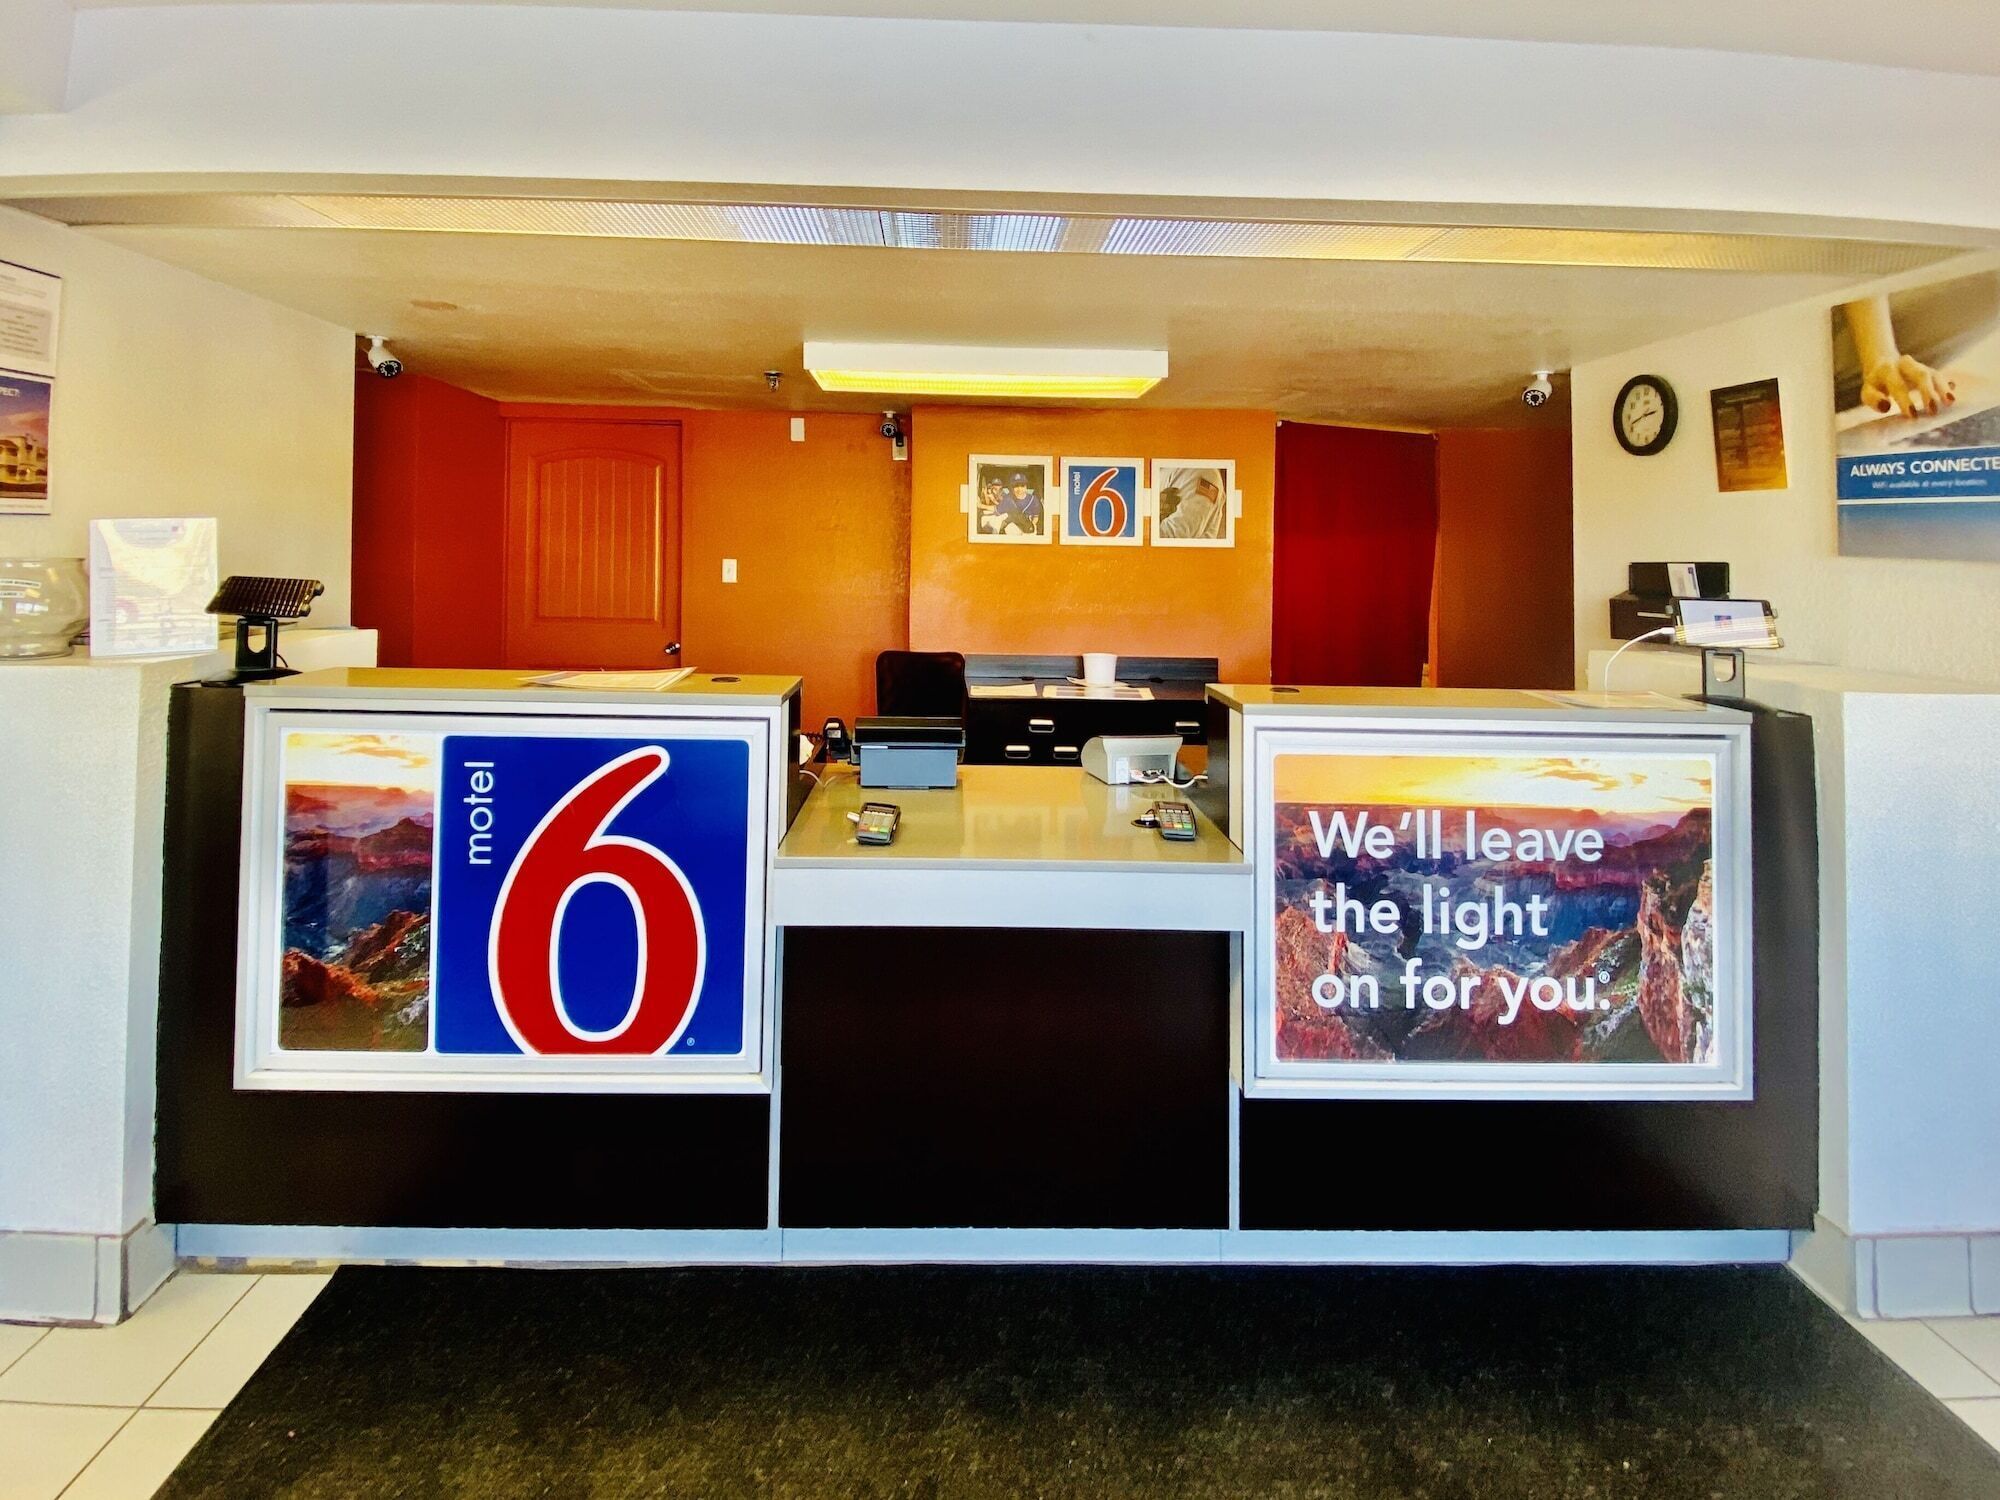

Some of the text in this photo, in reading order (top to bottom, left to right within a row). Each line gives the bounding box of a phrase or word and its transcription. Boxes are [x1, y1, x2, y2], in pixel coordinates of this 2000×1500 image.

[1850, 456, 2000, 477] ALWAYS CONNECTE
[1073, 467, 1128, 537] motel 6
[1308, 810, 1604, 862] We'll leave
[463, 745, 707, 1055] motel 6
[1309, 883, 1549, 950] the light
[1311, 972, 1379, 1010] on
[1399, 958, 1481, 1010] for
